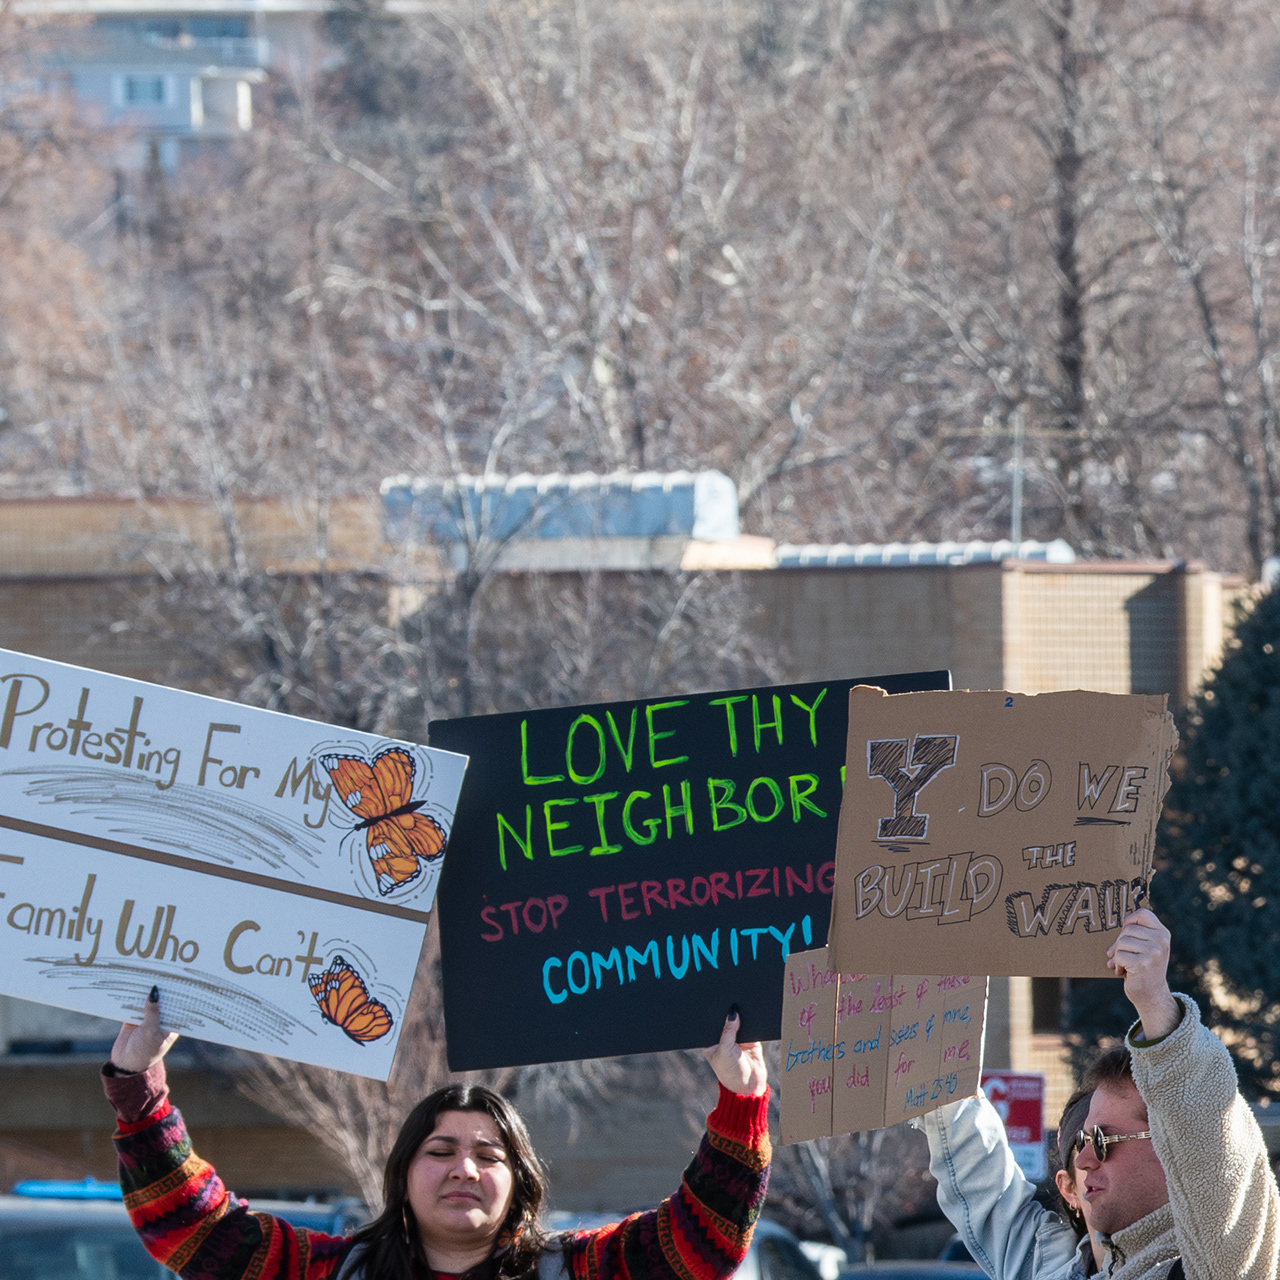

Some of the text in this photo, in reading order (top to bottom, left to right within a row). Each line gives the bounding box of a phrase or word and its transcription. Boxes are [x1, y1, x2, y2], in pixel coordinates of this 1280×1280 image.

[0, 674, 333, 829] Protesting For My
[520, 688, 827, 785] LOVE THY
[496, 766, 845, 871] NEIGHBOR
[867, 734, 1149, 840] Y DO WE
[480, 861, 836, 942] STOP TERRORIZING
[853, 840, 1077, 925] BUILD THE
[115, 900, 199, 963] Who
[223, 920, 323, 983] Can't
[542, 914, 812, 1005] COMMUNITY!
[854, 1024, 881, 1053] and
[809, 1075, 832, 1114] you
[846, 1064, 869, 1088] did
[895, 1052, 915, 1086] for
